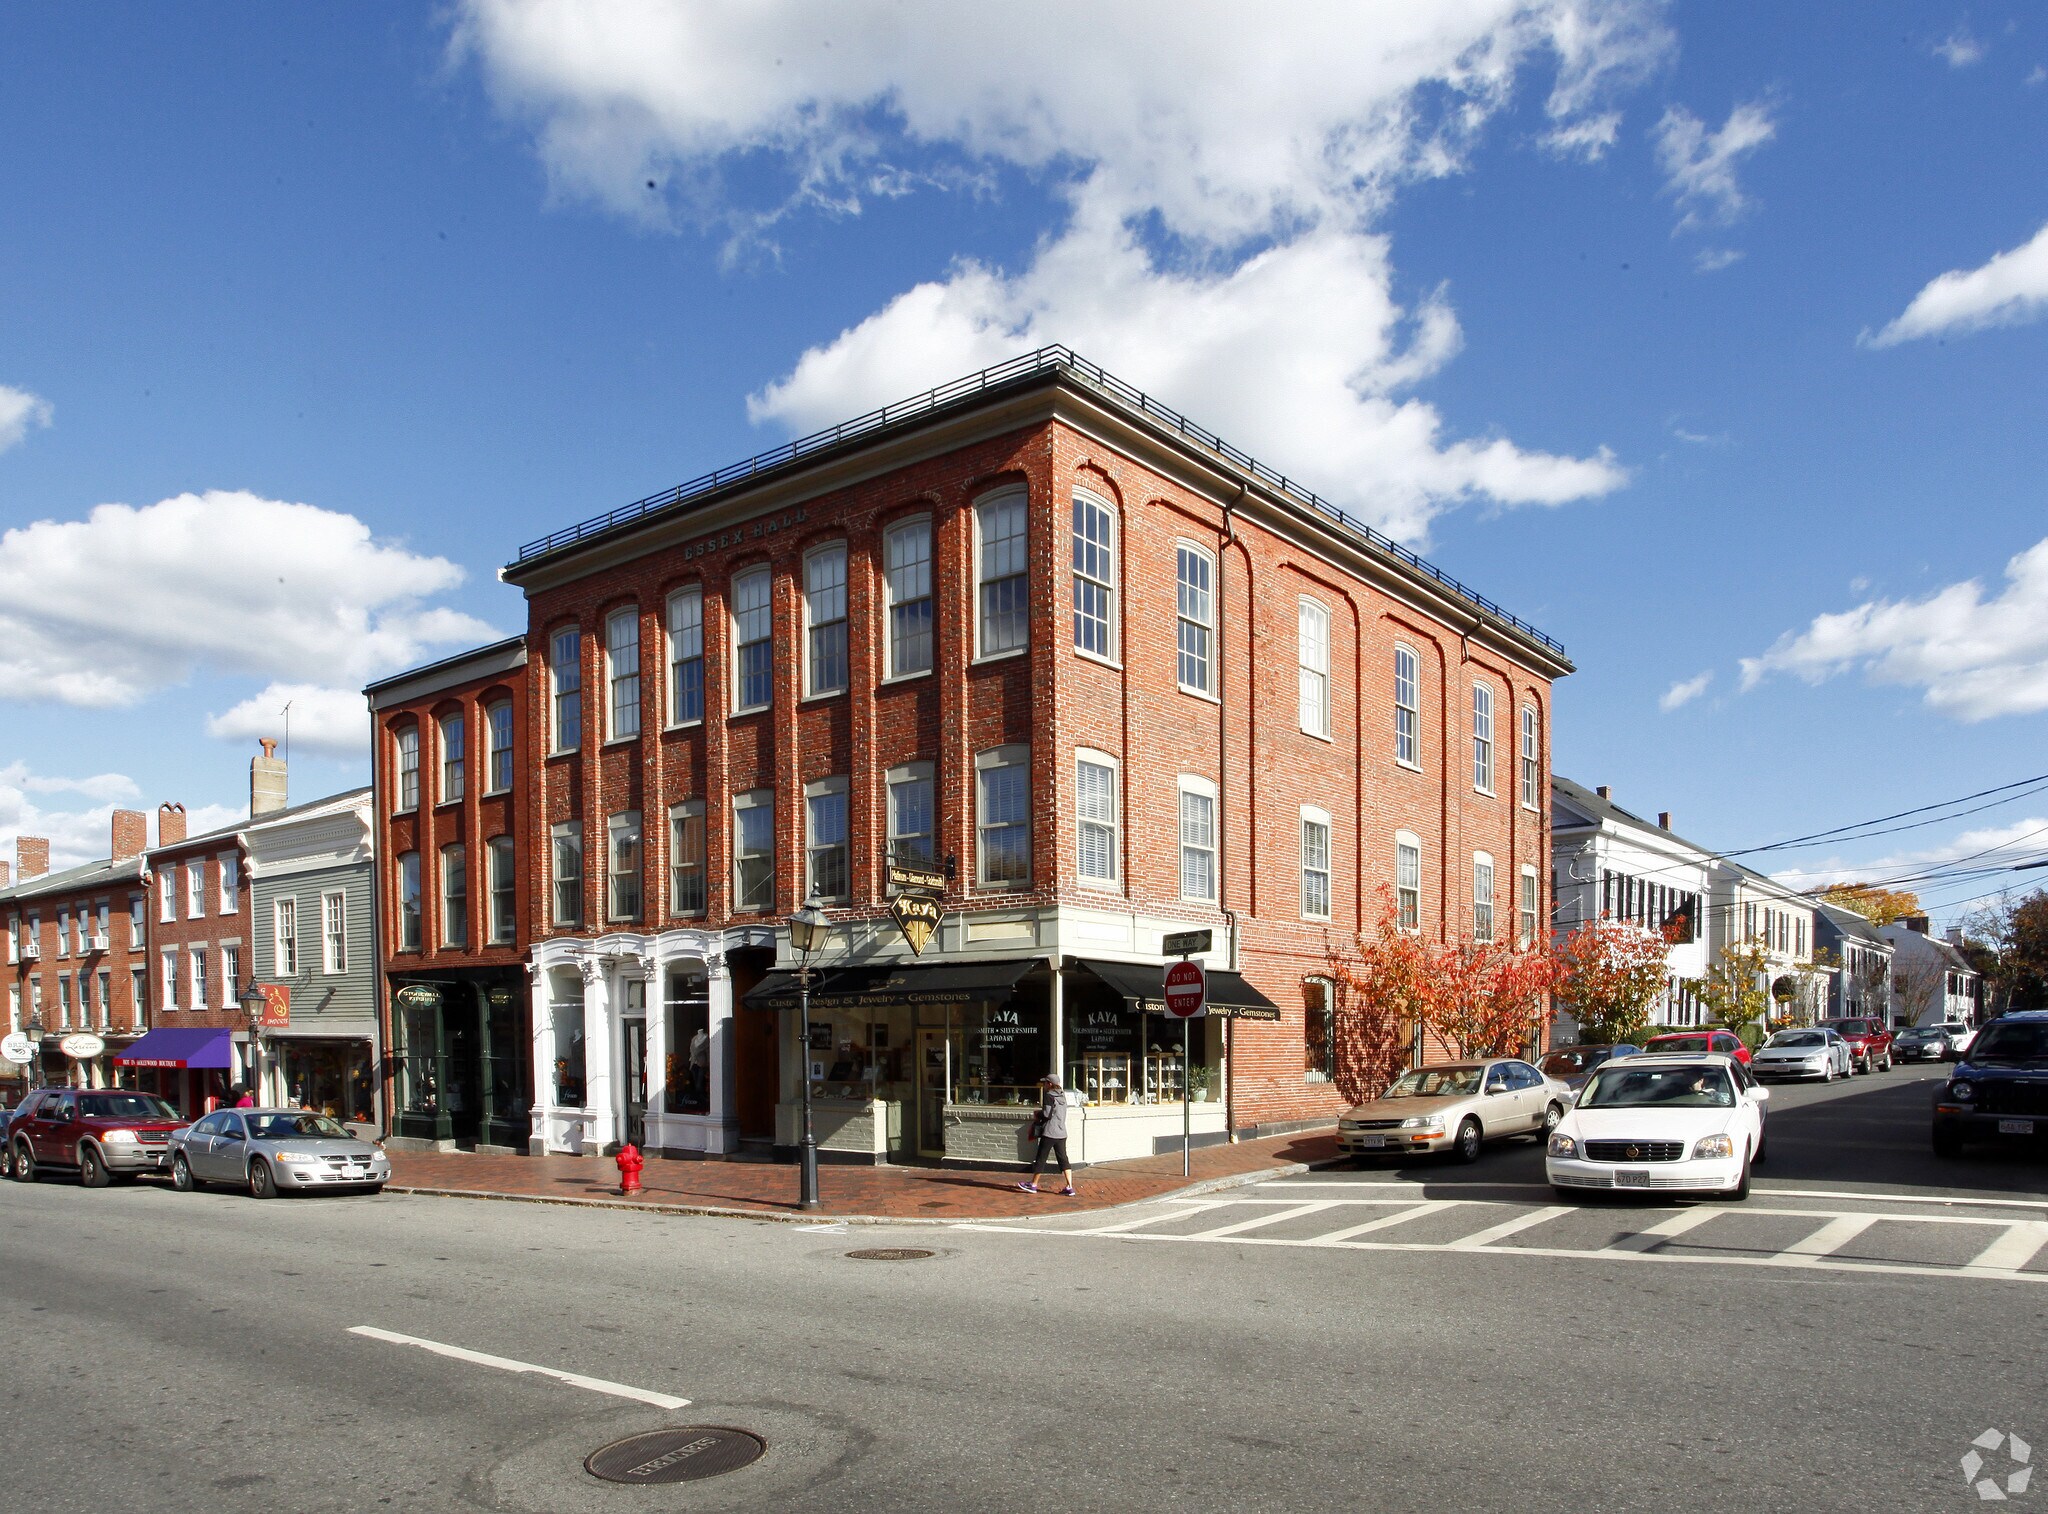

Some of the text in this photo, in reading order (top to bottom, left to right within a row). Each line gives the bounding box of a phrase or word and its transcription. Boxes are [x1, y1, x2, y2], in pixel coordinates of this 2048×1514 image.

[684, 510, 808, 561] ESSEX HALL
[898, 899, 938, 920] Kaya
[1167, 938, 1197, 950] ONE WAY
[1172, 971, 1196, 983] DO NOT
[808, 997, 839, 1007] Design
[843, 996, 854, 1005] &
[859, 994, 896, 1005] Jewelry
[907, 992, 971, 1002] Gemstones
[1174, 997, 1195, 1008] ENTER
[1087, 1011, 1118, 1026] KAYA
[1206, 1005, 1232, 1017] Jewelry
[1239, 1007, 1276, 1018] Gemstones
